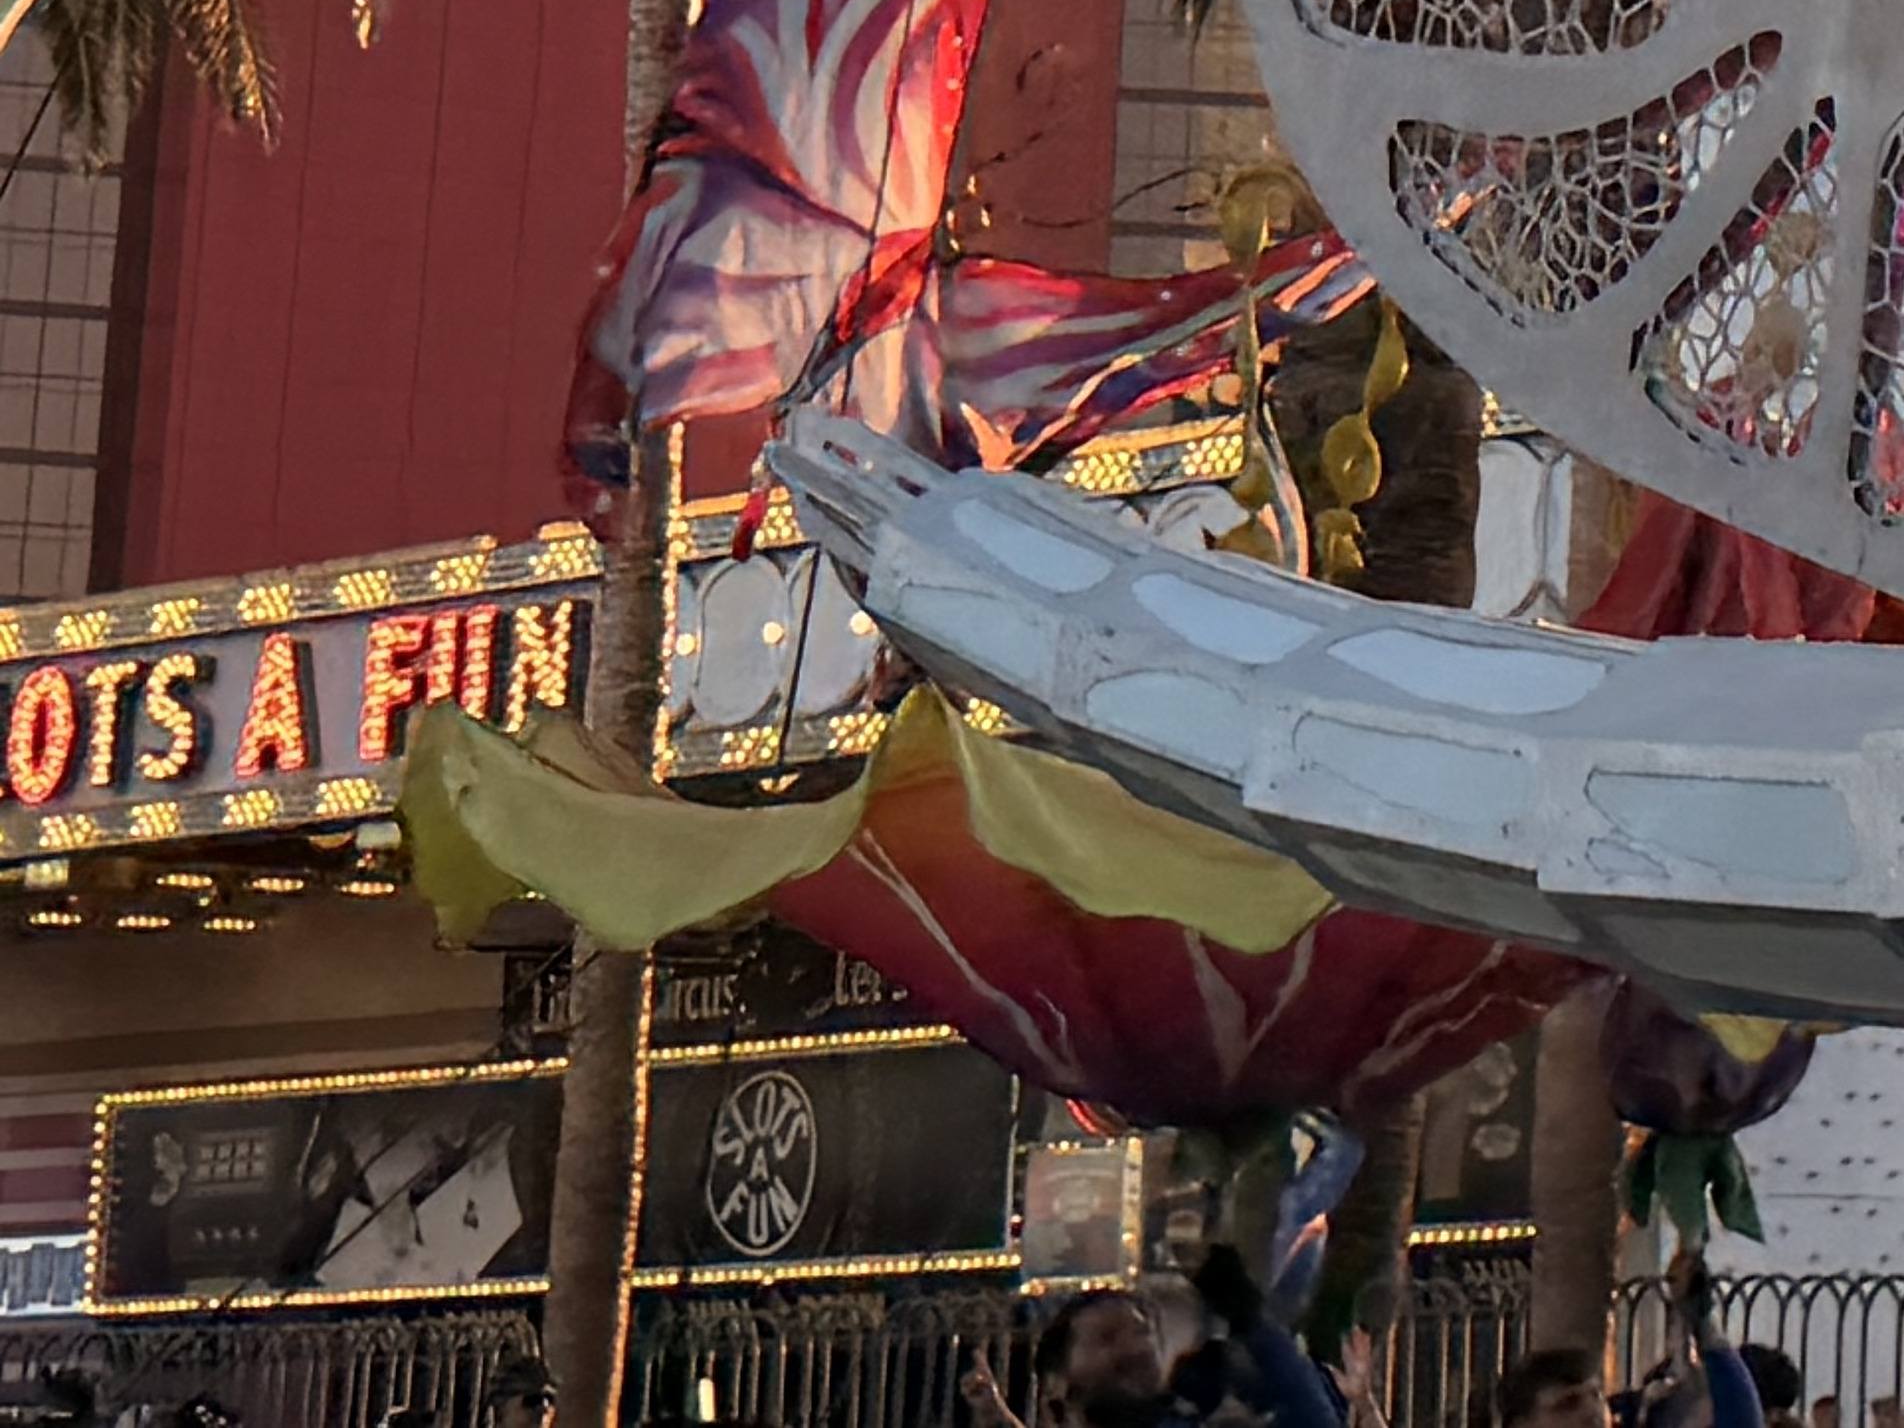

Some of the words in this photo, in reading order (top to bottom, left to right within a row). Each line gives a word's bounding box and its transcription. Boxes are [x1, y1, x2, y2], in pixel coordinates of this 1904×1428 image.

[0, 652, 197, 806] OTS
[235, 631, 307, 778] A
[359, 598, 574, 763] FUN
[716, 1080, 811, 1166] SLOTS
[749, 1147, 769, 1181] A
[719, 1176, 800, 1246] FUN
